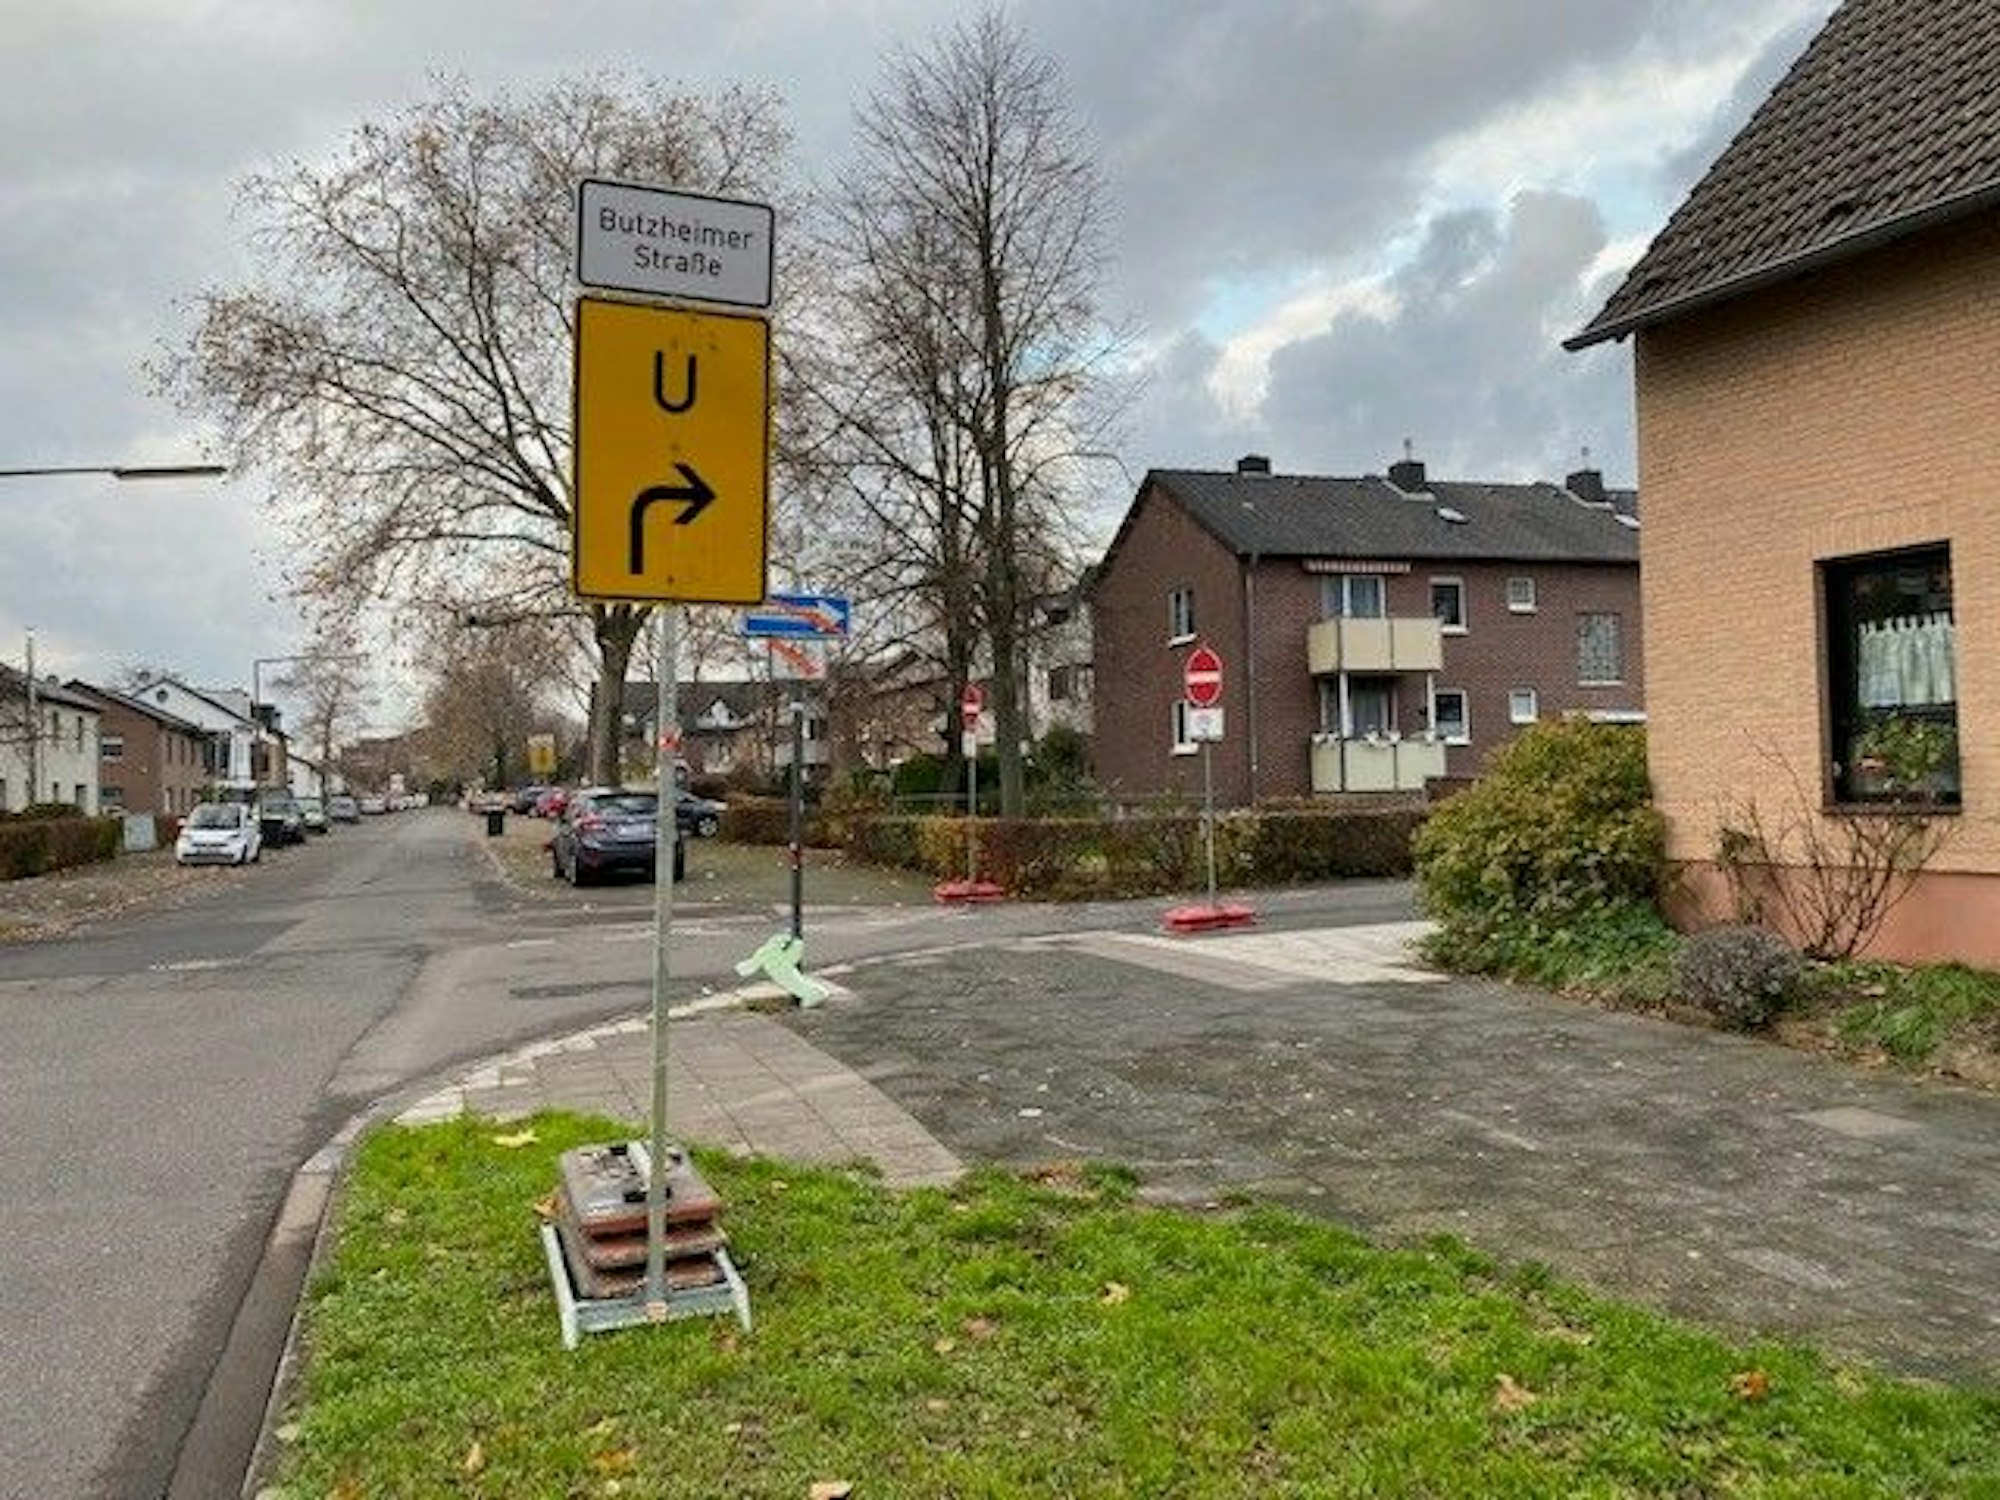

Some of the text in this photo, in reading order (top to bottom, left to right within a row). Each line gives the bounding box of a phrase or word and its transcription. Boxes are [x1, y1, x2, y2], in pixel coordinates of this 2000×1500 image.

[600, 208, 753, 249] Butzheimer
[634, 245, 722, 276] Straße
[655, 350, 697, 413] U
